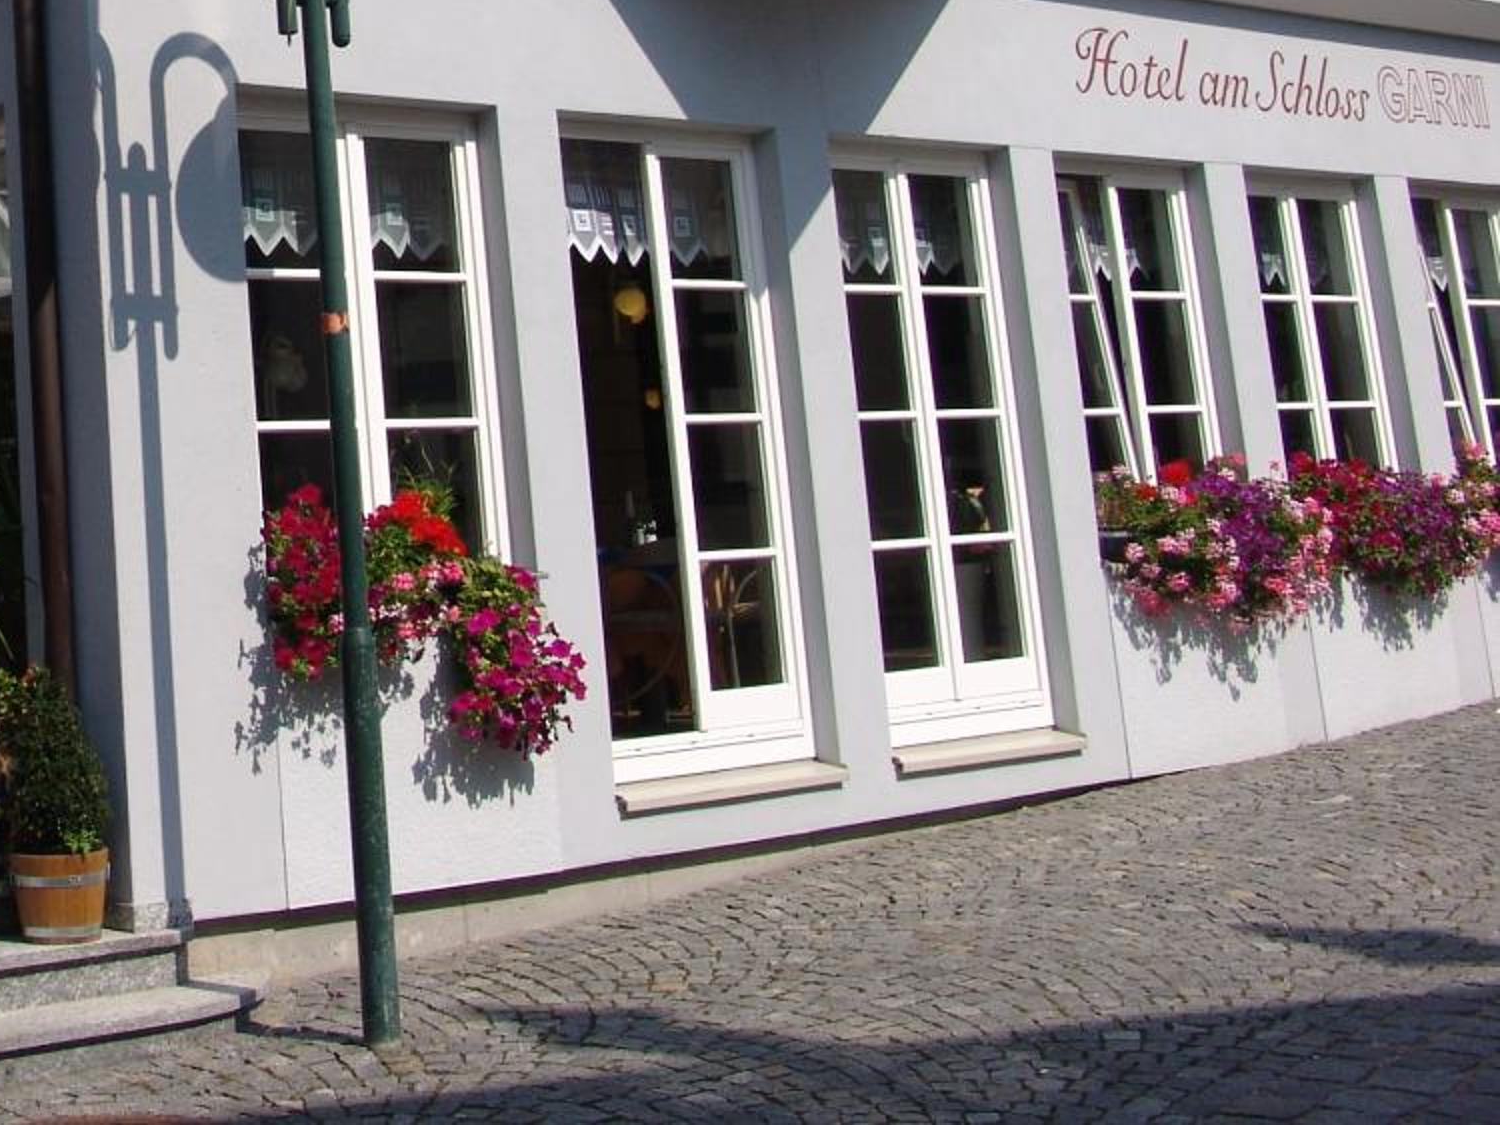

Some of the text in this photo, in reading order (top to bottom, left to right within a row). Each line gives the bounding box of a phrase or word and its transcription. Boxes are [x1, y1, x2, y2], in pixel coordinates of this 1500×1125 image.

[1075, 27, 1491, 130] Hotel am Schloss GARNI
